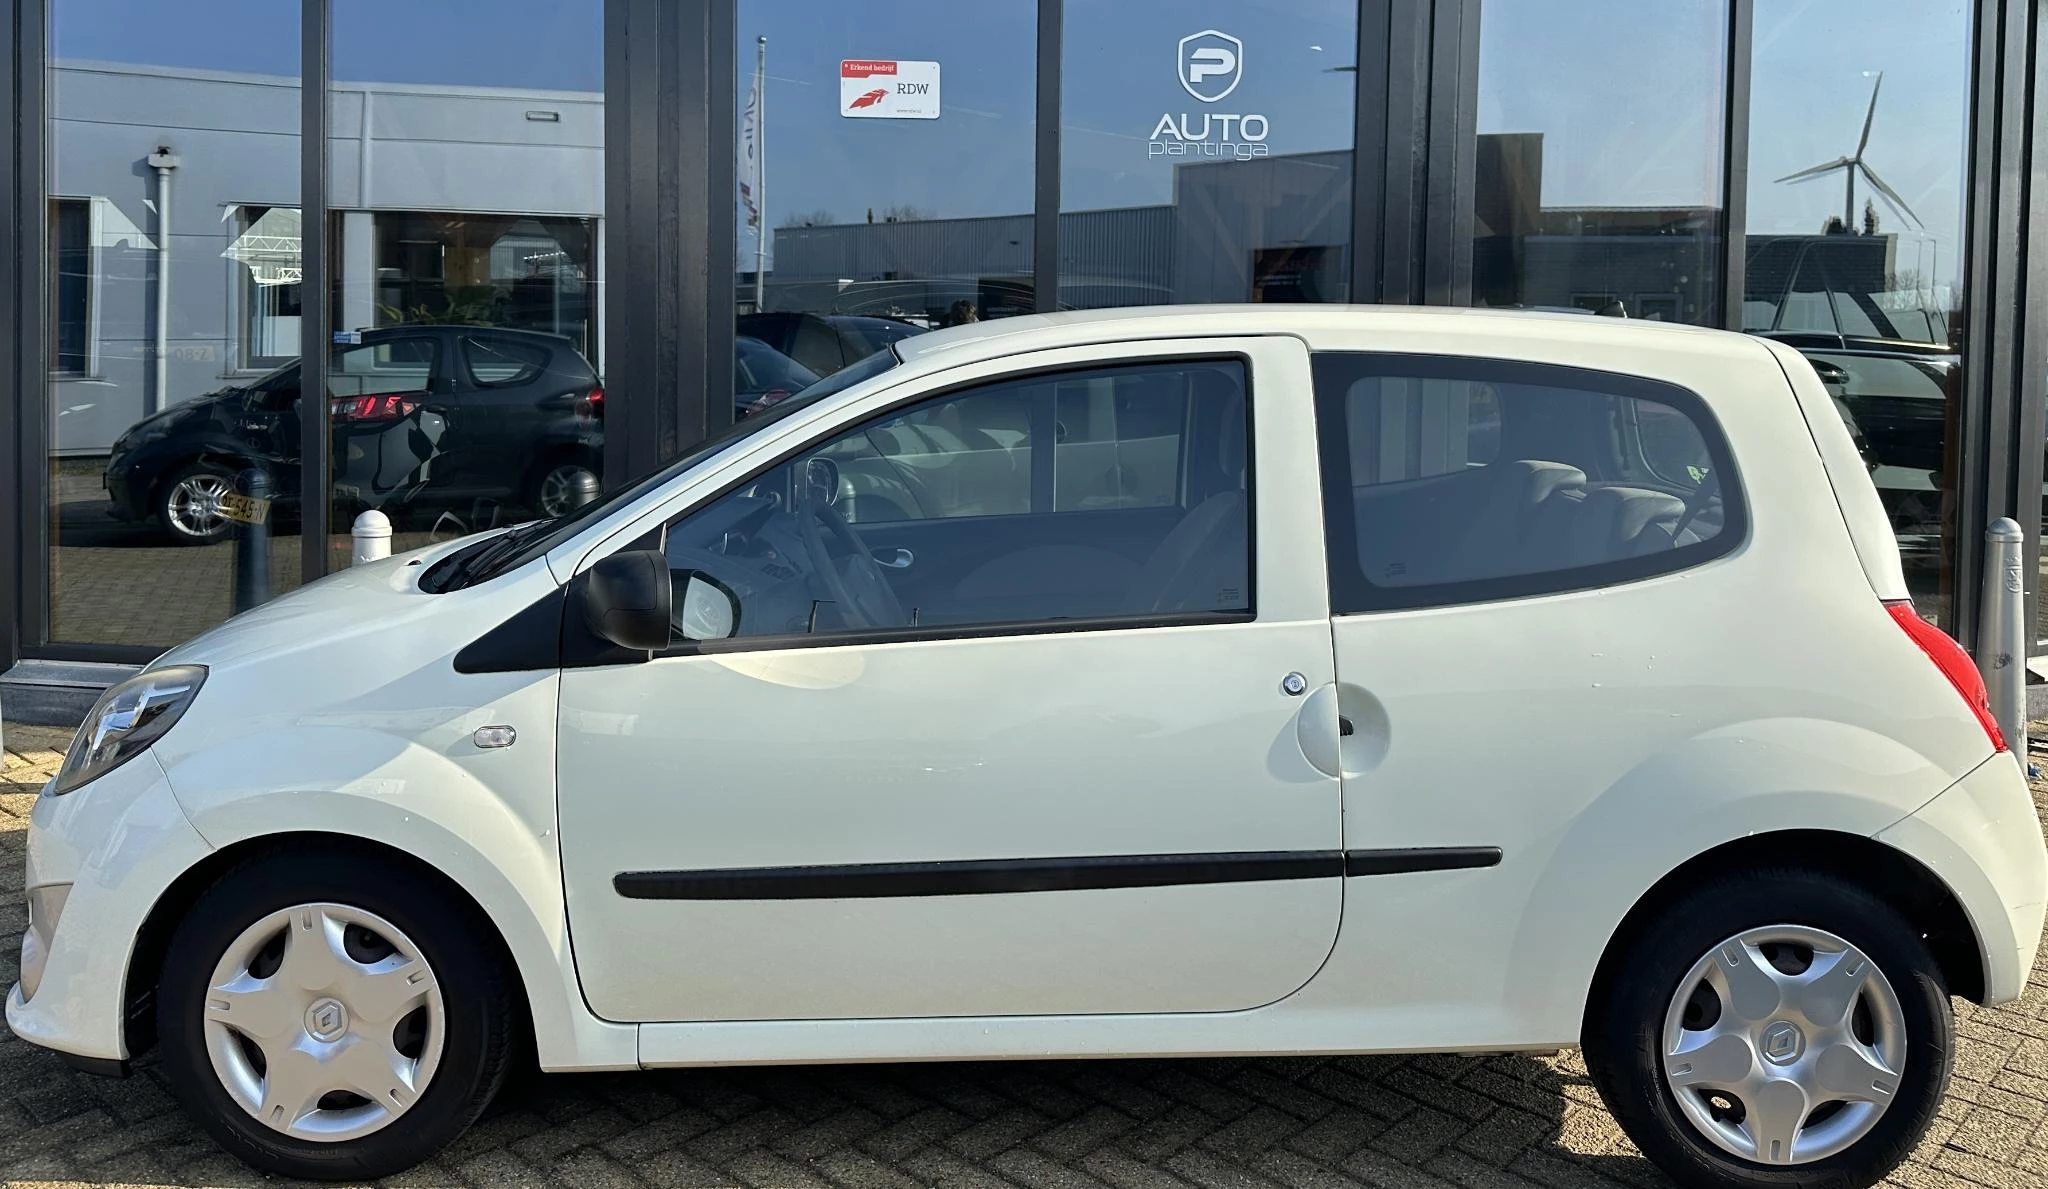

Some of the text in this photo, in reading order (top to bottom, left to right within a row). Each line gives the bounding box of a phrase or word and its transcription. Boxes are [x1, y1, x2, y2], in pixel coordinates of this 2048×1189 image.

[874, 65, 895, 73] bedrijf
[1190, 48, 1236, 83] P
[897, 83, 929, 95] RDW
[1149, 113, 1269, 141] AUTO
[1148, 140, 1269, 161] plantinga
